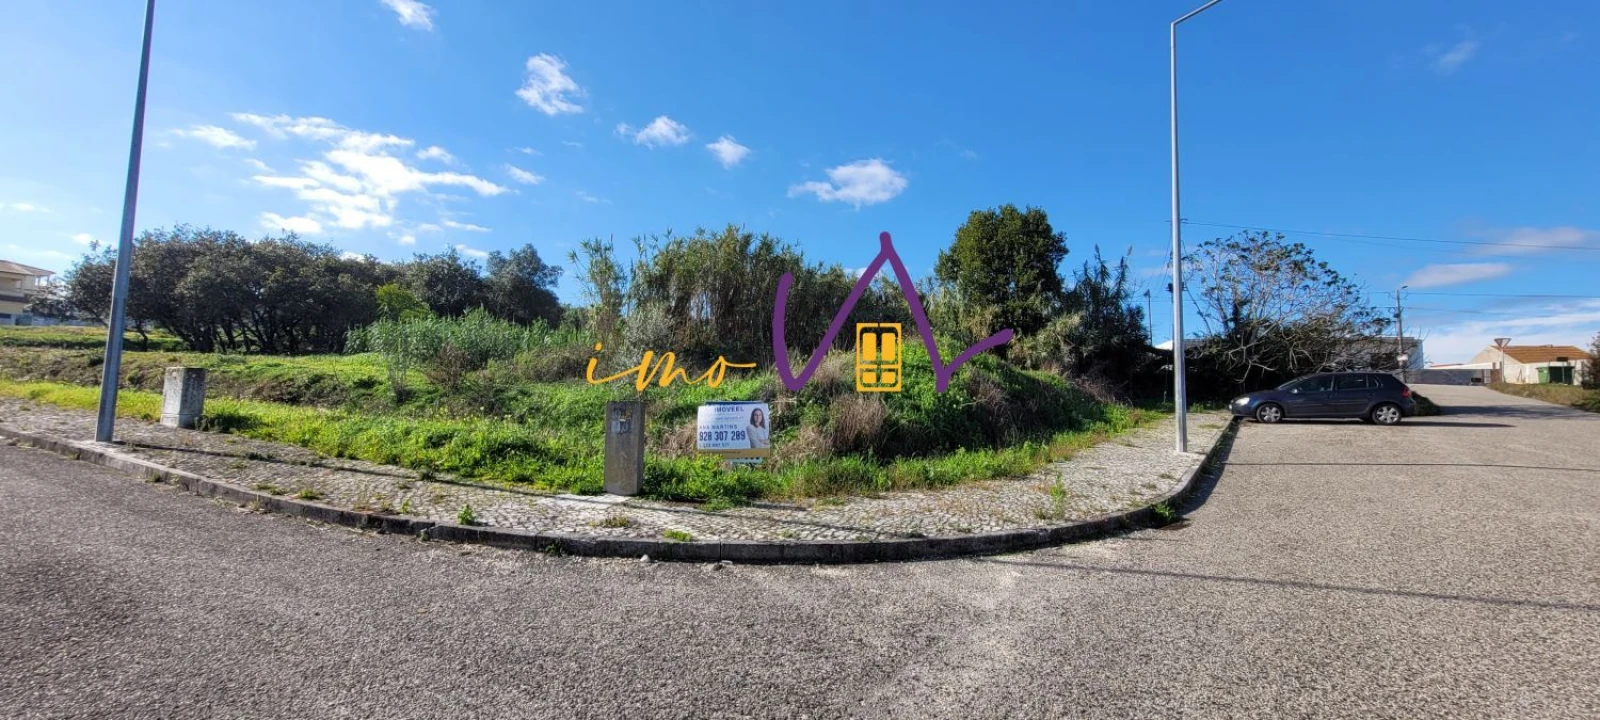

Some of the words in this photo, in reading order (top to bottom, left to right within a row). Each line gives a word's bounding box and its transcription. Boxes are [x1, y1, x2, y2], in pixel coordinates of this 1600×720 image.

[699, 431, 712, 441] 928
[714, 431, 728, 441] 307
[731, 430, 746, 441] 289
